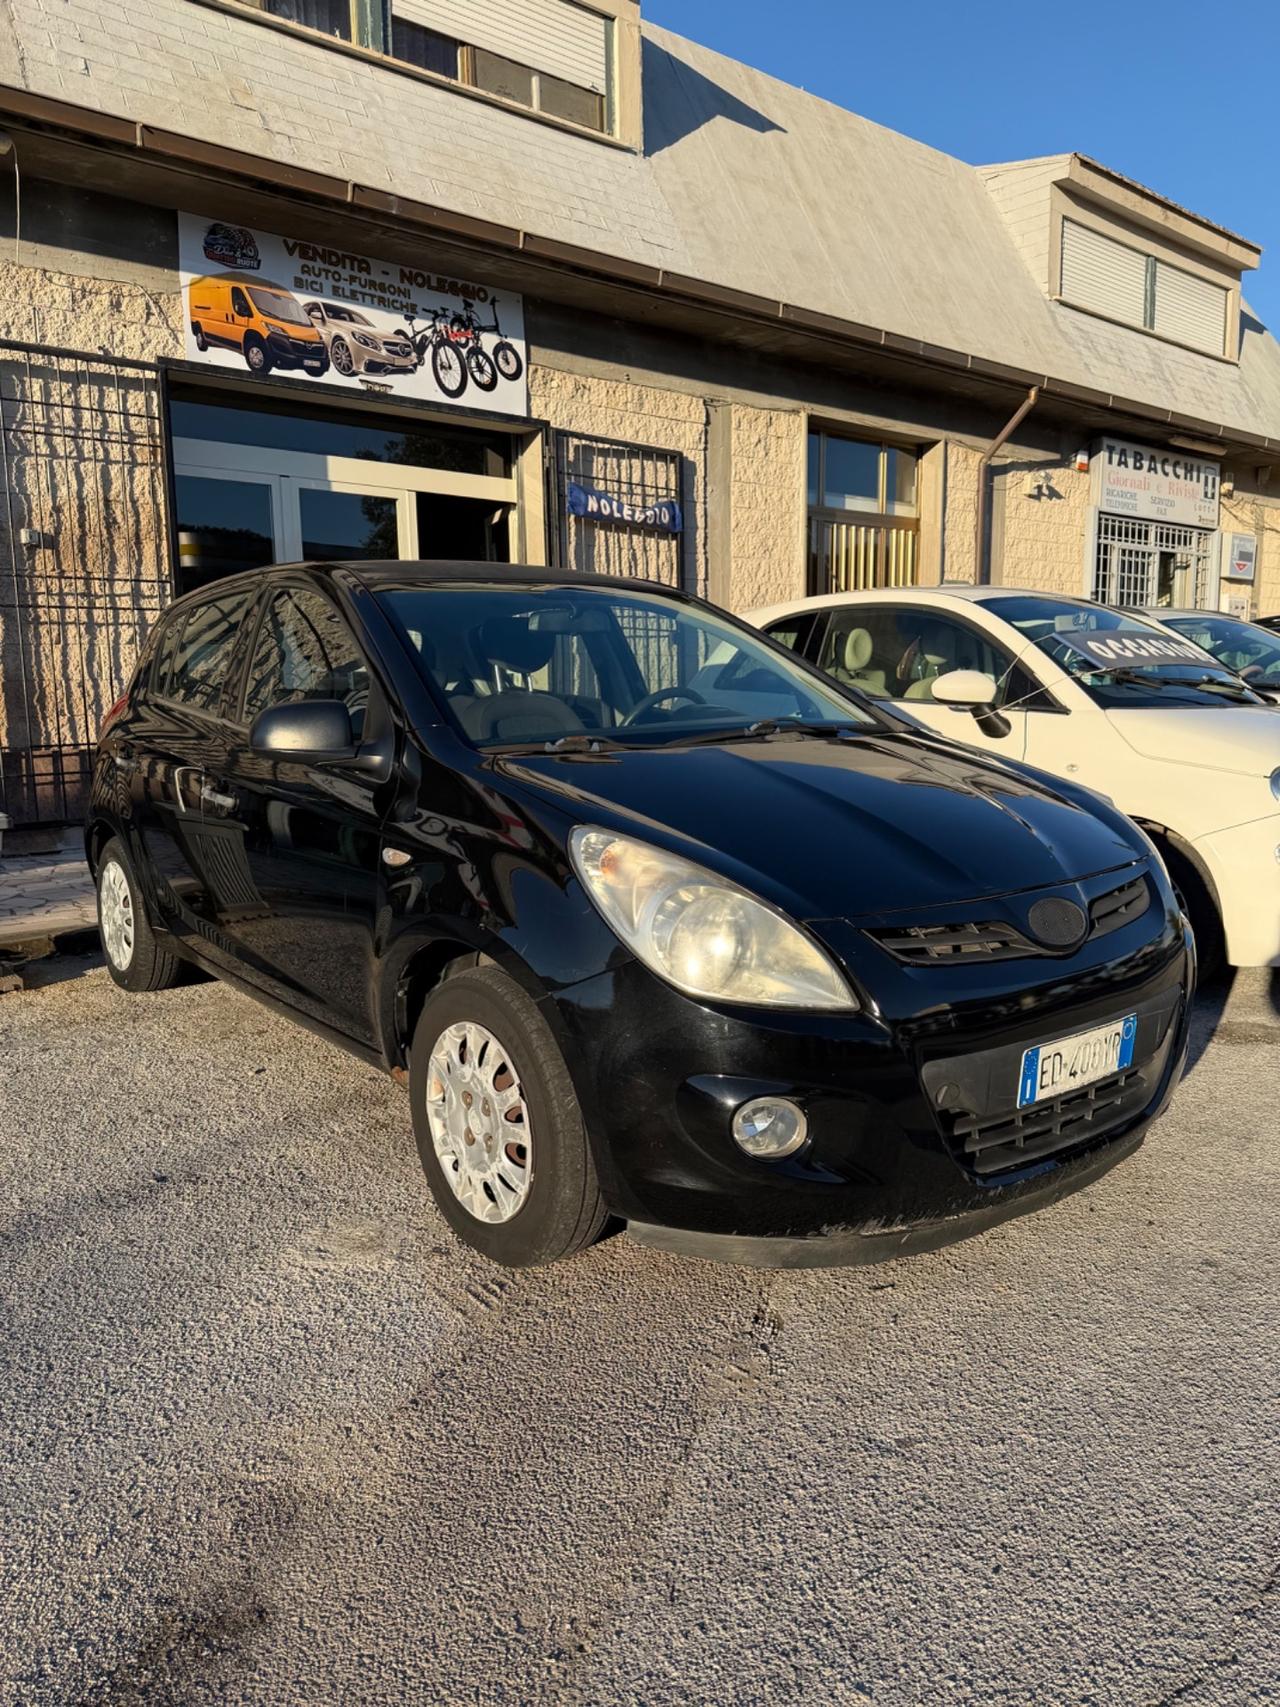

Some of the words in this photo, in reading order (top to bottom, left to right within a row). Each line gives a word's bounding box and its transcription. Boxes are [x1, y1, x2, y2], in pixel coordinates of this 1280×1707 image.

[282, 239, 371, 275] VENDITA
[399, 267, 489, 303] NOLEGGIO
[300, 263, 411, 299] AUTO-FURGONI
[293, 276, 323, 294] BICI
[331, 285, 418, 315] ELETTRICHE
[1106, 444, 1200, 483] TABACCHI
[1107, 470, 1150, 491] Giornali
[1167, 480, 1200, 500] Riviste
